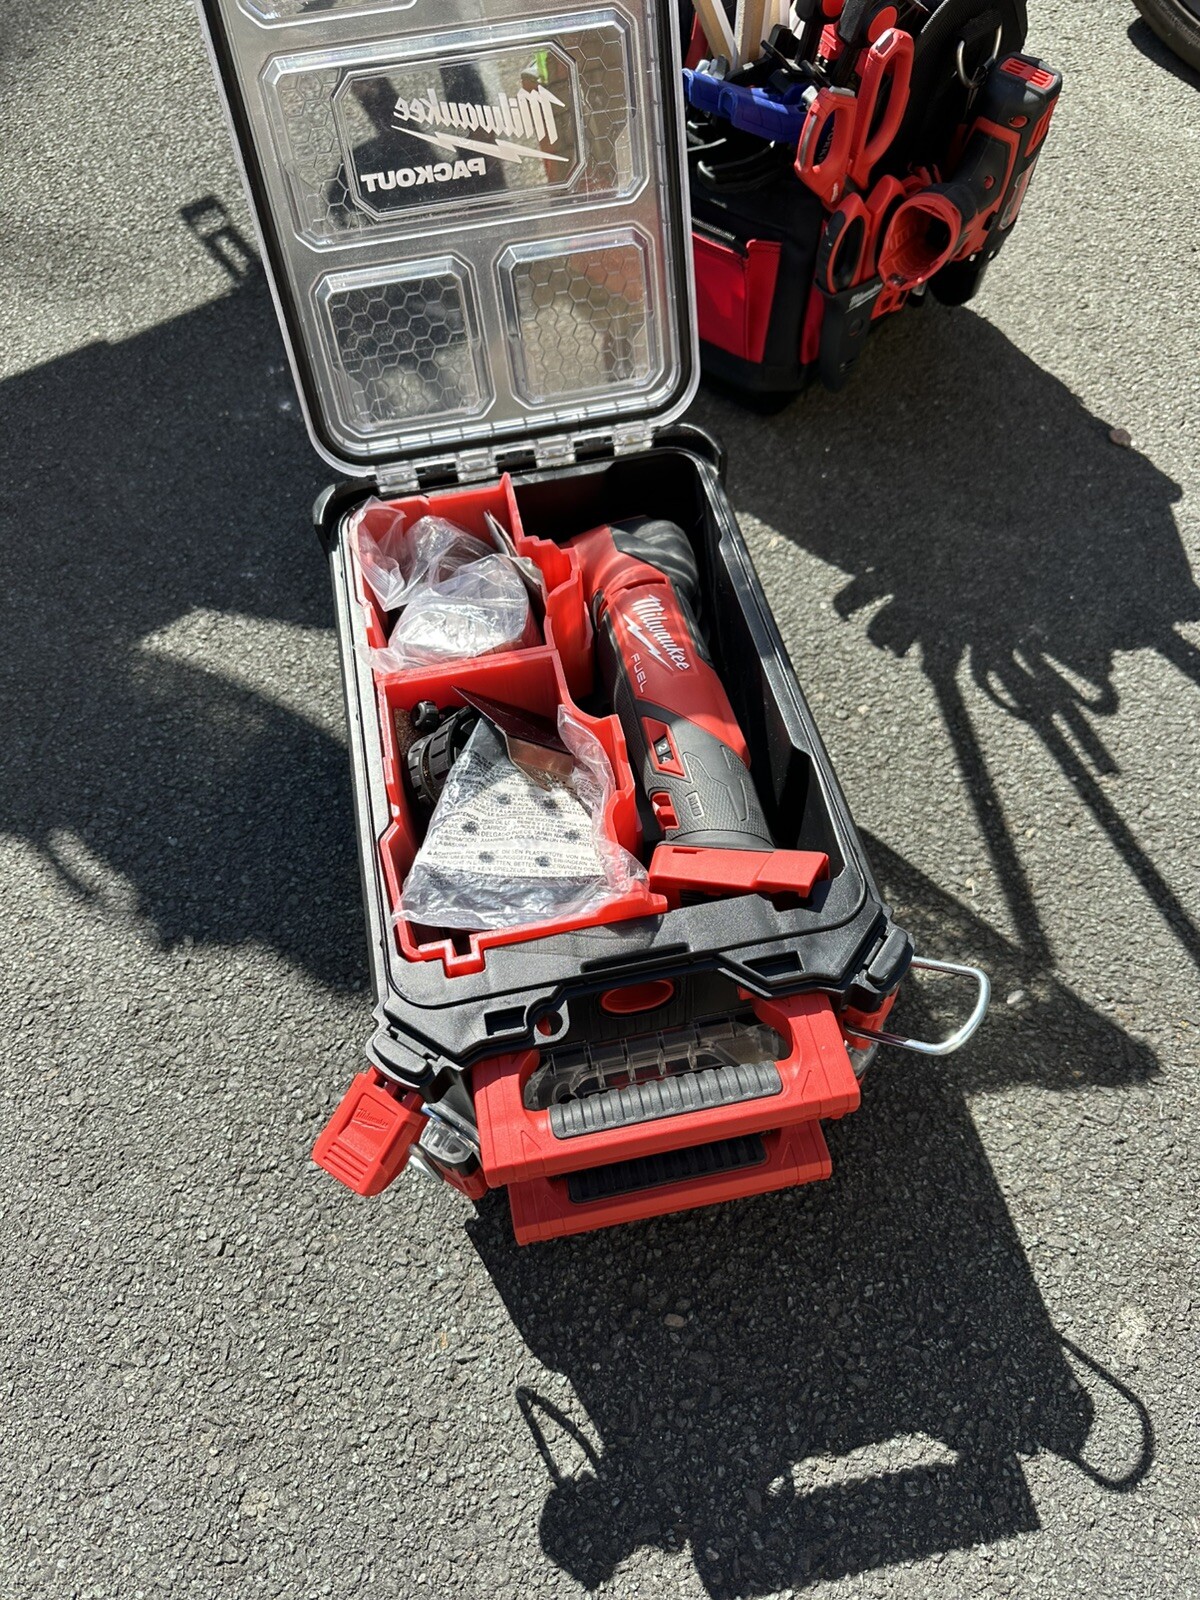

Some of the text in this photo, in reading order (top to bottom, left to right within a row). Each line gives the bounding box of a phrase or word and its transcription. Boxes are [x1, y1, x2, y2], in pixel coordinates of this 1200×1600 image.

[632, 594, 690, 671] Milwaukee
[631, 653, 648, 693] FUEL
[658, 743, 667, 752] 2
